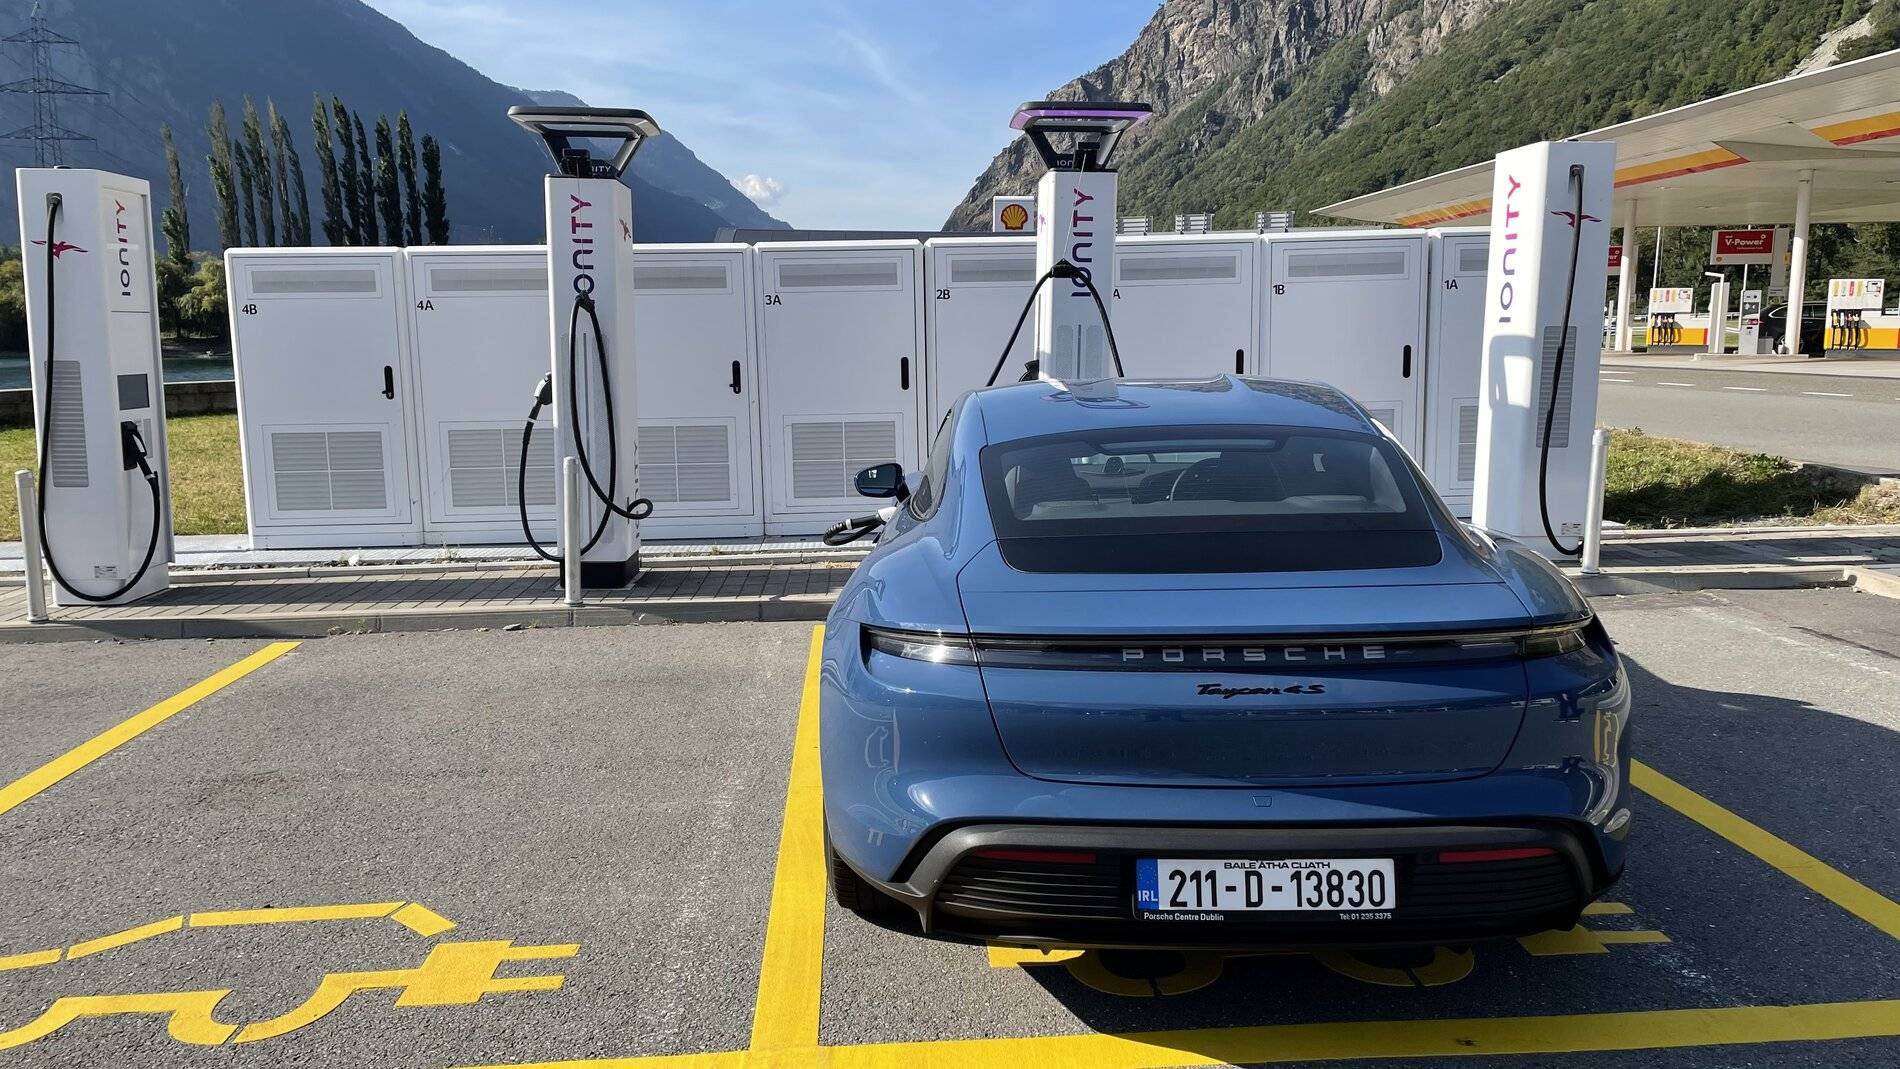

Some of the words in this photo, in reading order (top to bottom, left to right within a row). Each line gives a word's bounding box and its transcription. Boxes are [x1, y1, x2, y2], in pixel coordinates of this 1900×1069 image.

[115, 199, 131, 296] IONITY
[570, 194, 595, 296] ONITY
[1071, 188, 1095, 297] IONITY
[1725, 238, 1764, 246] V-Power
[1499, 174, 1521, 323] IONITY
[1272, 284, 1285, 295] 1B
[1444, 279, 1458, 290] 1A
[765, 294, 782, 306] 3A
[936, 289, 951, 300] 2B
[1112, 288, 1121, 300] A
[241, 303, 258, 315] 4B
[416, 299, 434, 311] 4A
[1122, 645, 1386, 662] PORSCHE
[1197, 683, 1281, 699] Taycan
[1283, 684, 1326, 695] 4S
[1168, 869, 1386, 907] 211-D-13830
[1138, 890, 1158, 902] IRL
[1144, 911, 1173, 920] Porsche
[1174, 912, 1199, 920] Centre
[1200, 913, 1224, 921] Dublin
